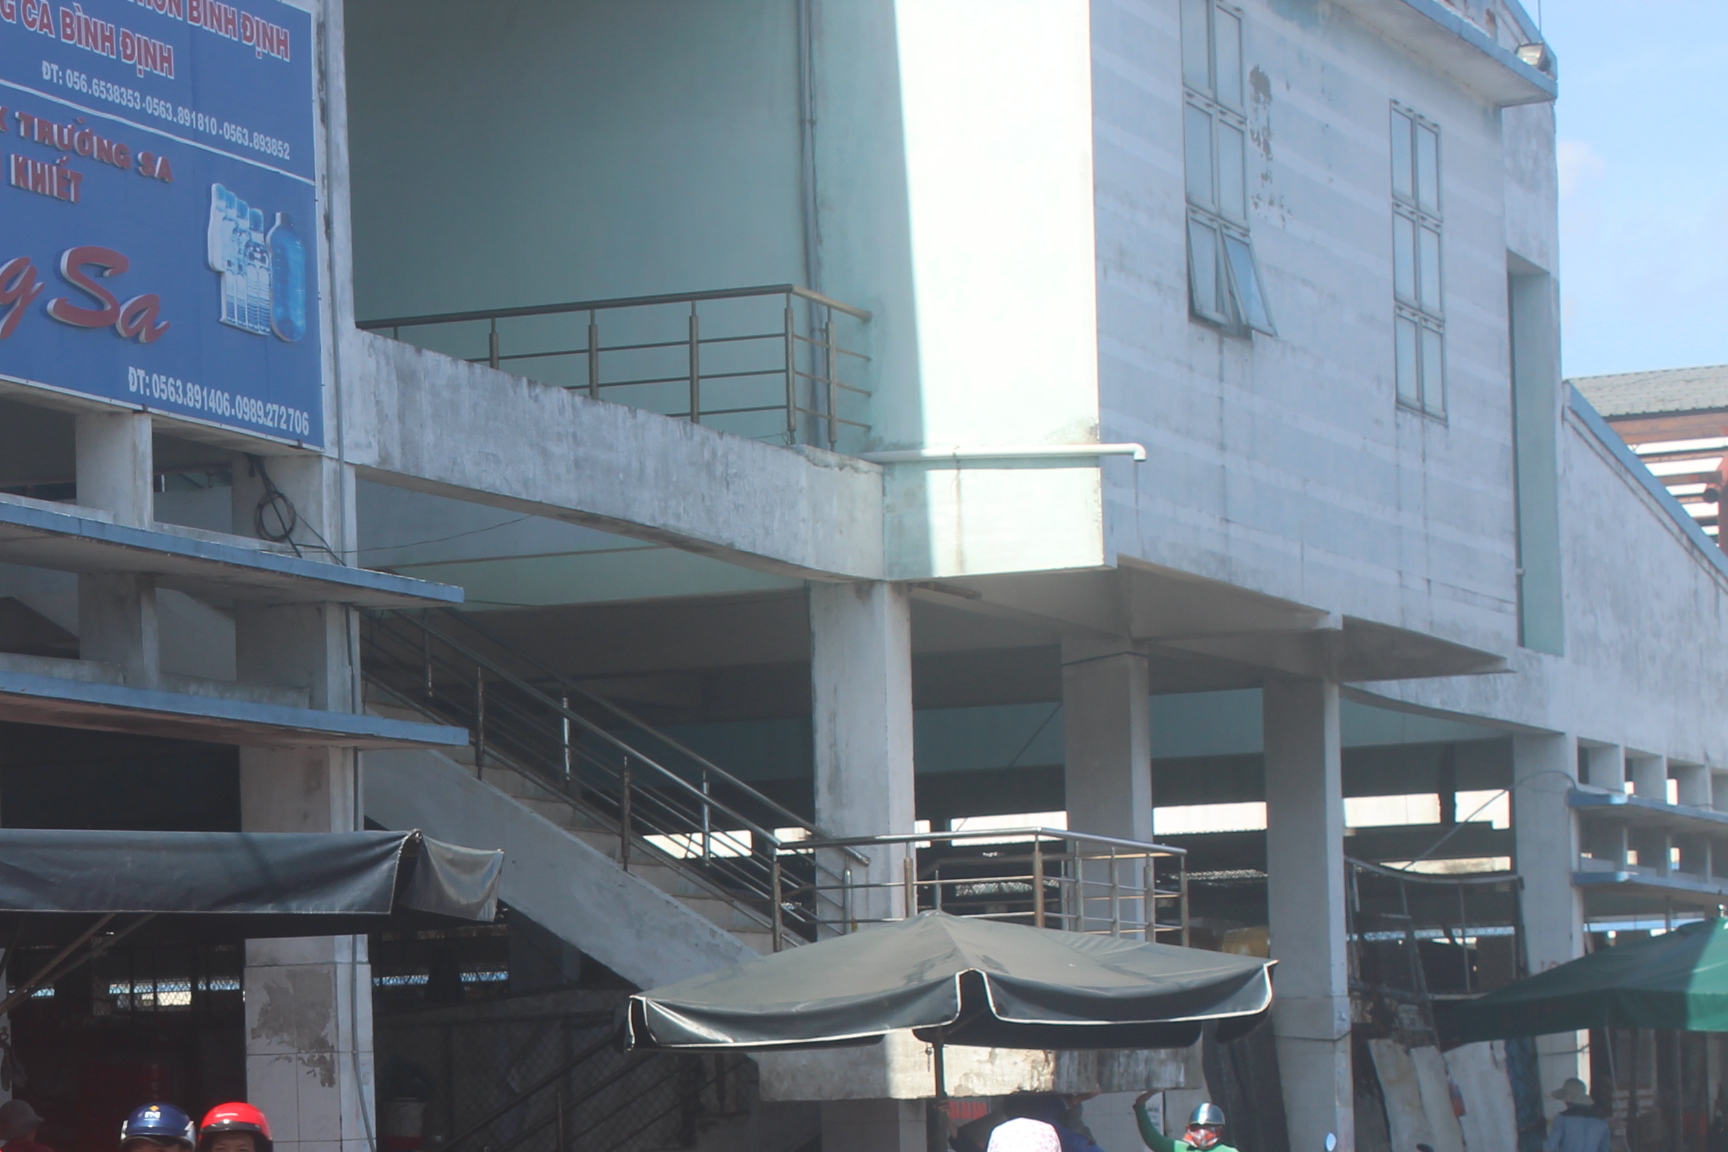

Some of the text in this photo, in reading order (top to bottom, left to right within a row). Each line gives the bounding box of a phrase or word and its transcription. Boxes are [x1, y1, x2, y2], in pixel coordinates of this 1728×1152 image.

[59, 3, 116, 59] BÌNH
[120, 28, 174, 79] ĐỊNH
[241, 11, 290, 62] ĐỊNH
[42, 60, 63, 85] ĐT:
[15, 111, 132, 170] TRƯỜNG
[137, 151, 174, 183] SA
[10, 155, 83, 203] KHIẾT
[47, 245, 170, 343] Sa
[128, 366, 150, 396] ĐT:
